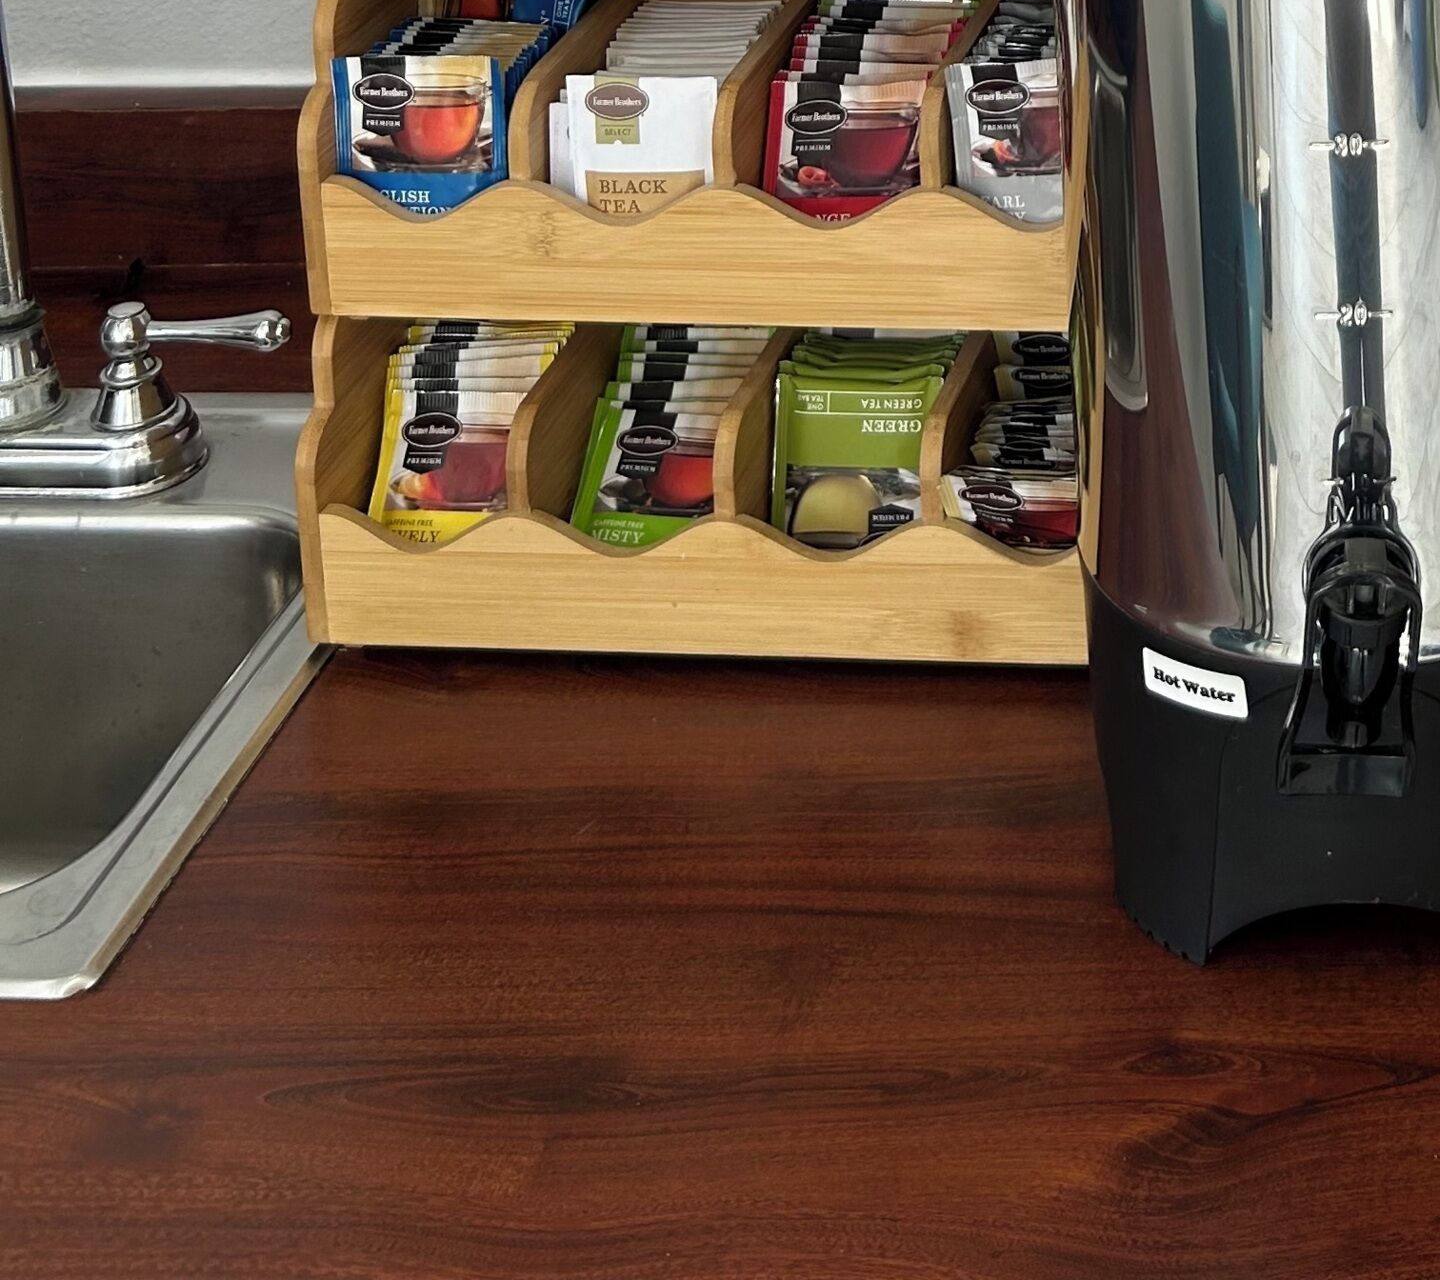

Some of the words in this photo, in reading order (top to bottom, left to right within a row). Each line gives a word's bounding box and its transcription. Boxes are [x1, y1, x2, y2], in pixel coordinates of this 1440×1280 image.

[359, 86, 381, 97] Farmer
[381, 87, 409, 98] Brothers
[791, 112, 813, 123] Farmer
[813, 111, 841, 122] Brothers
[1334, 132, 1363, 157] 30
[599, 179, 669, 194] BLACK
[380, 190, 430, 203] GLISH
[599, 199, 642, 213] TEA
[1340, 302, 1368, 328] 20
[861, 398, 882, 409] TEA
[883, 398, 922, 409] GREEN
[861, 419, 922, 433] GREEN
[391, 529, 441, 543] VELY
[591, 529, 645, 544] MISTY
[1152, 665, 1182, 689] Hot
[1181, 677, 1236, 703] Water
